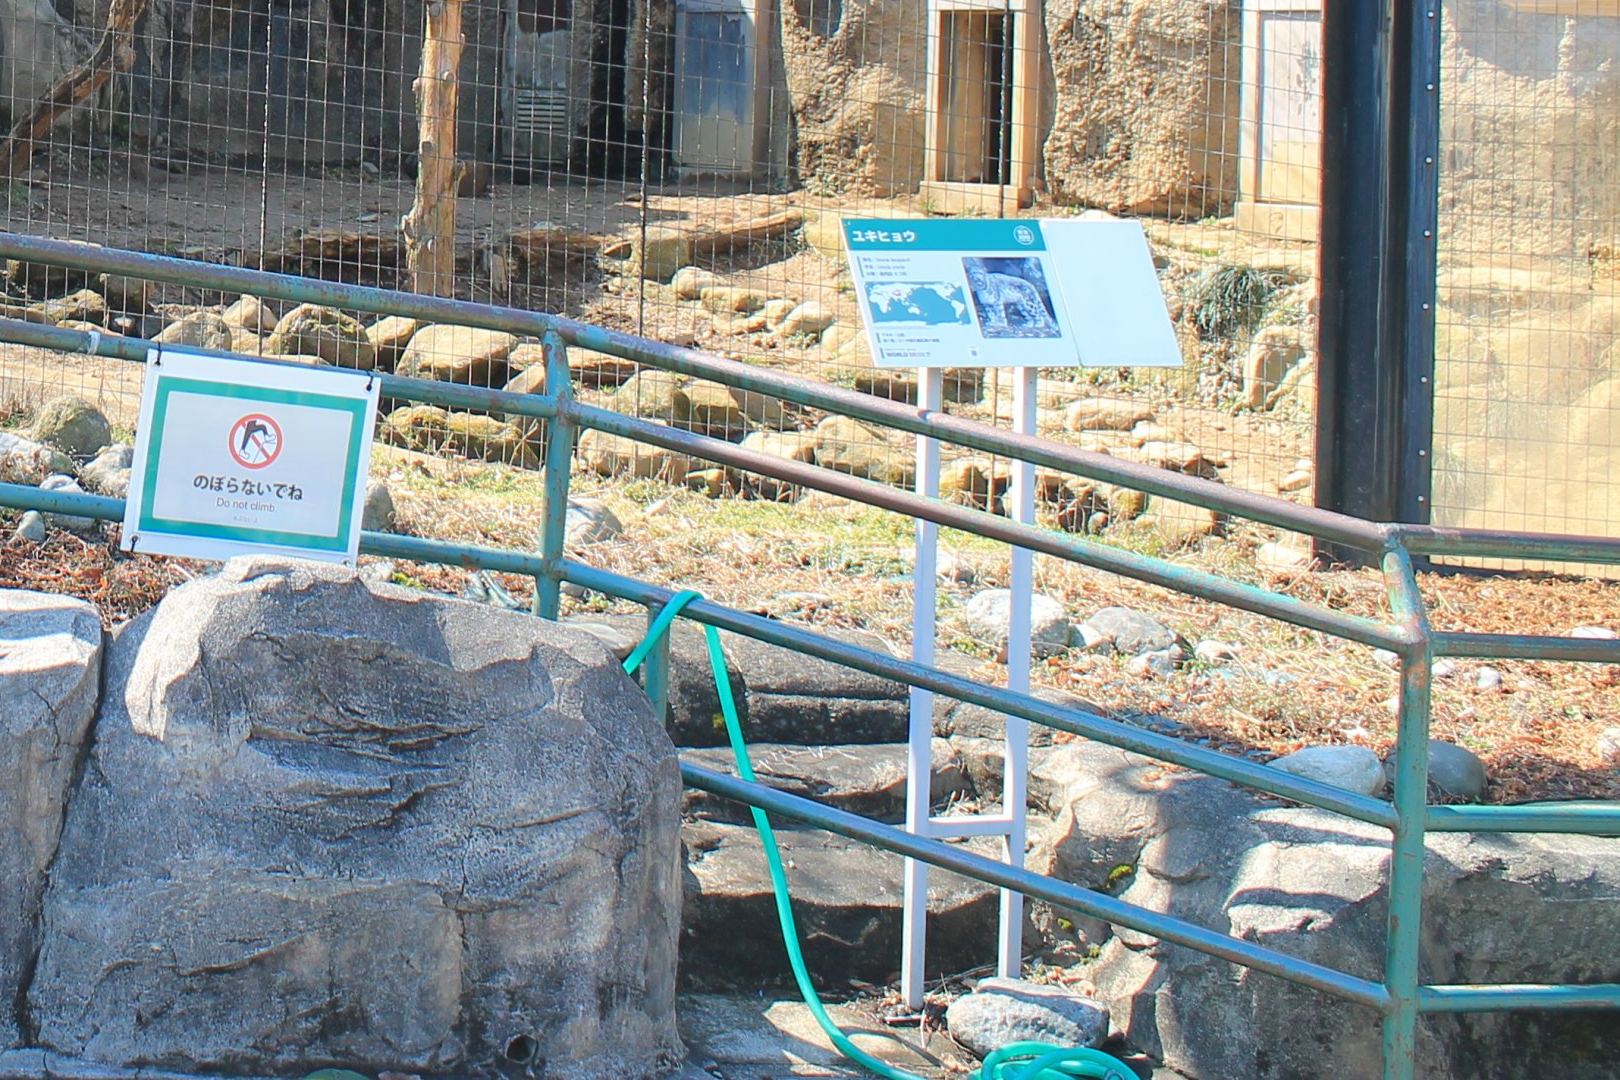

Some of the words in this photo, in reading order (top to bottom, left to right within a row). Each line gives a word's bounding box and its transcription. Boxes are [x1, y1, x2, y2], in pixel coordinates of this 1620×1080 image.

[852, 230, 915, 242] ユキヒョウ
[193, 474, 303, 500] のぼらないでね
[216, 497, 230, 508] Do
[233, 501, 248, 510] not
[250, 501, 278, 513] climb.
